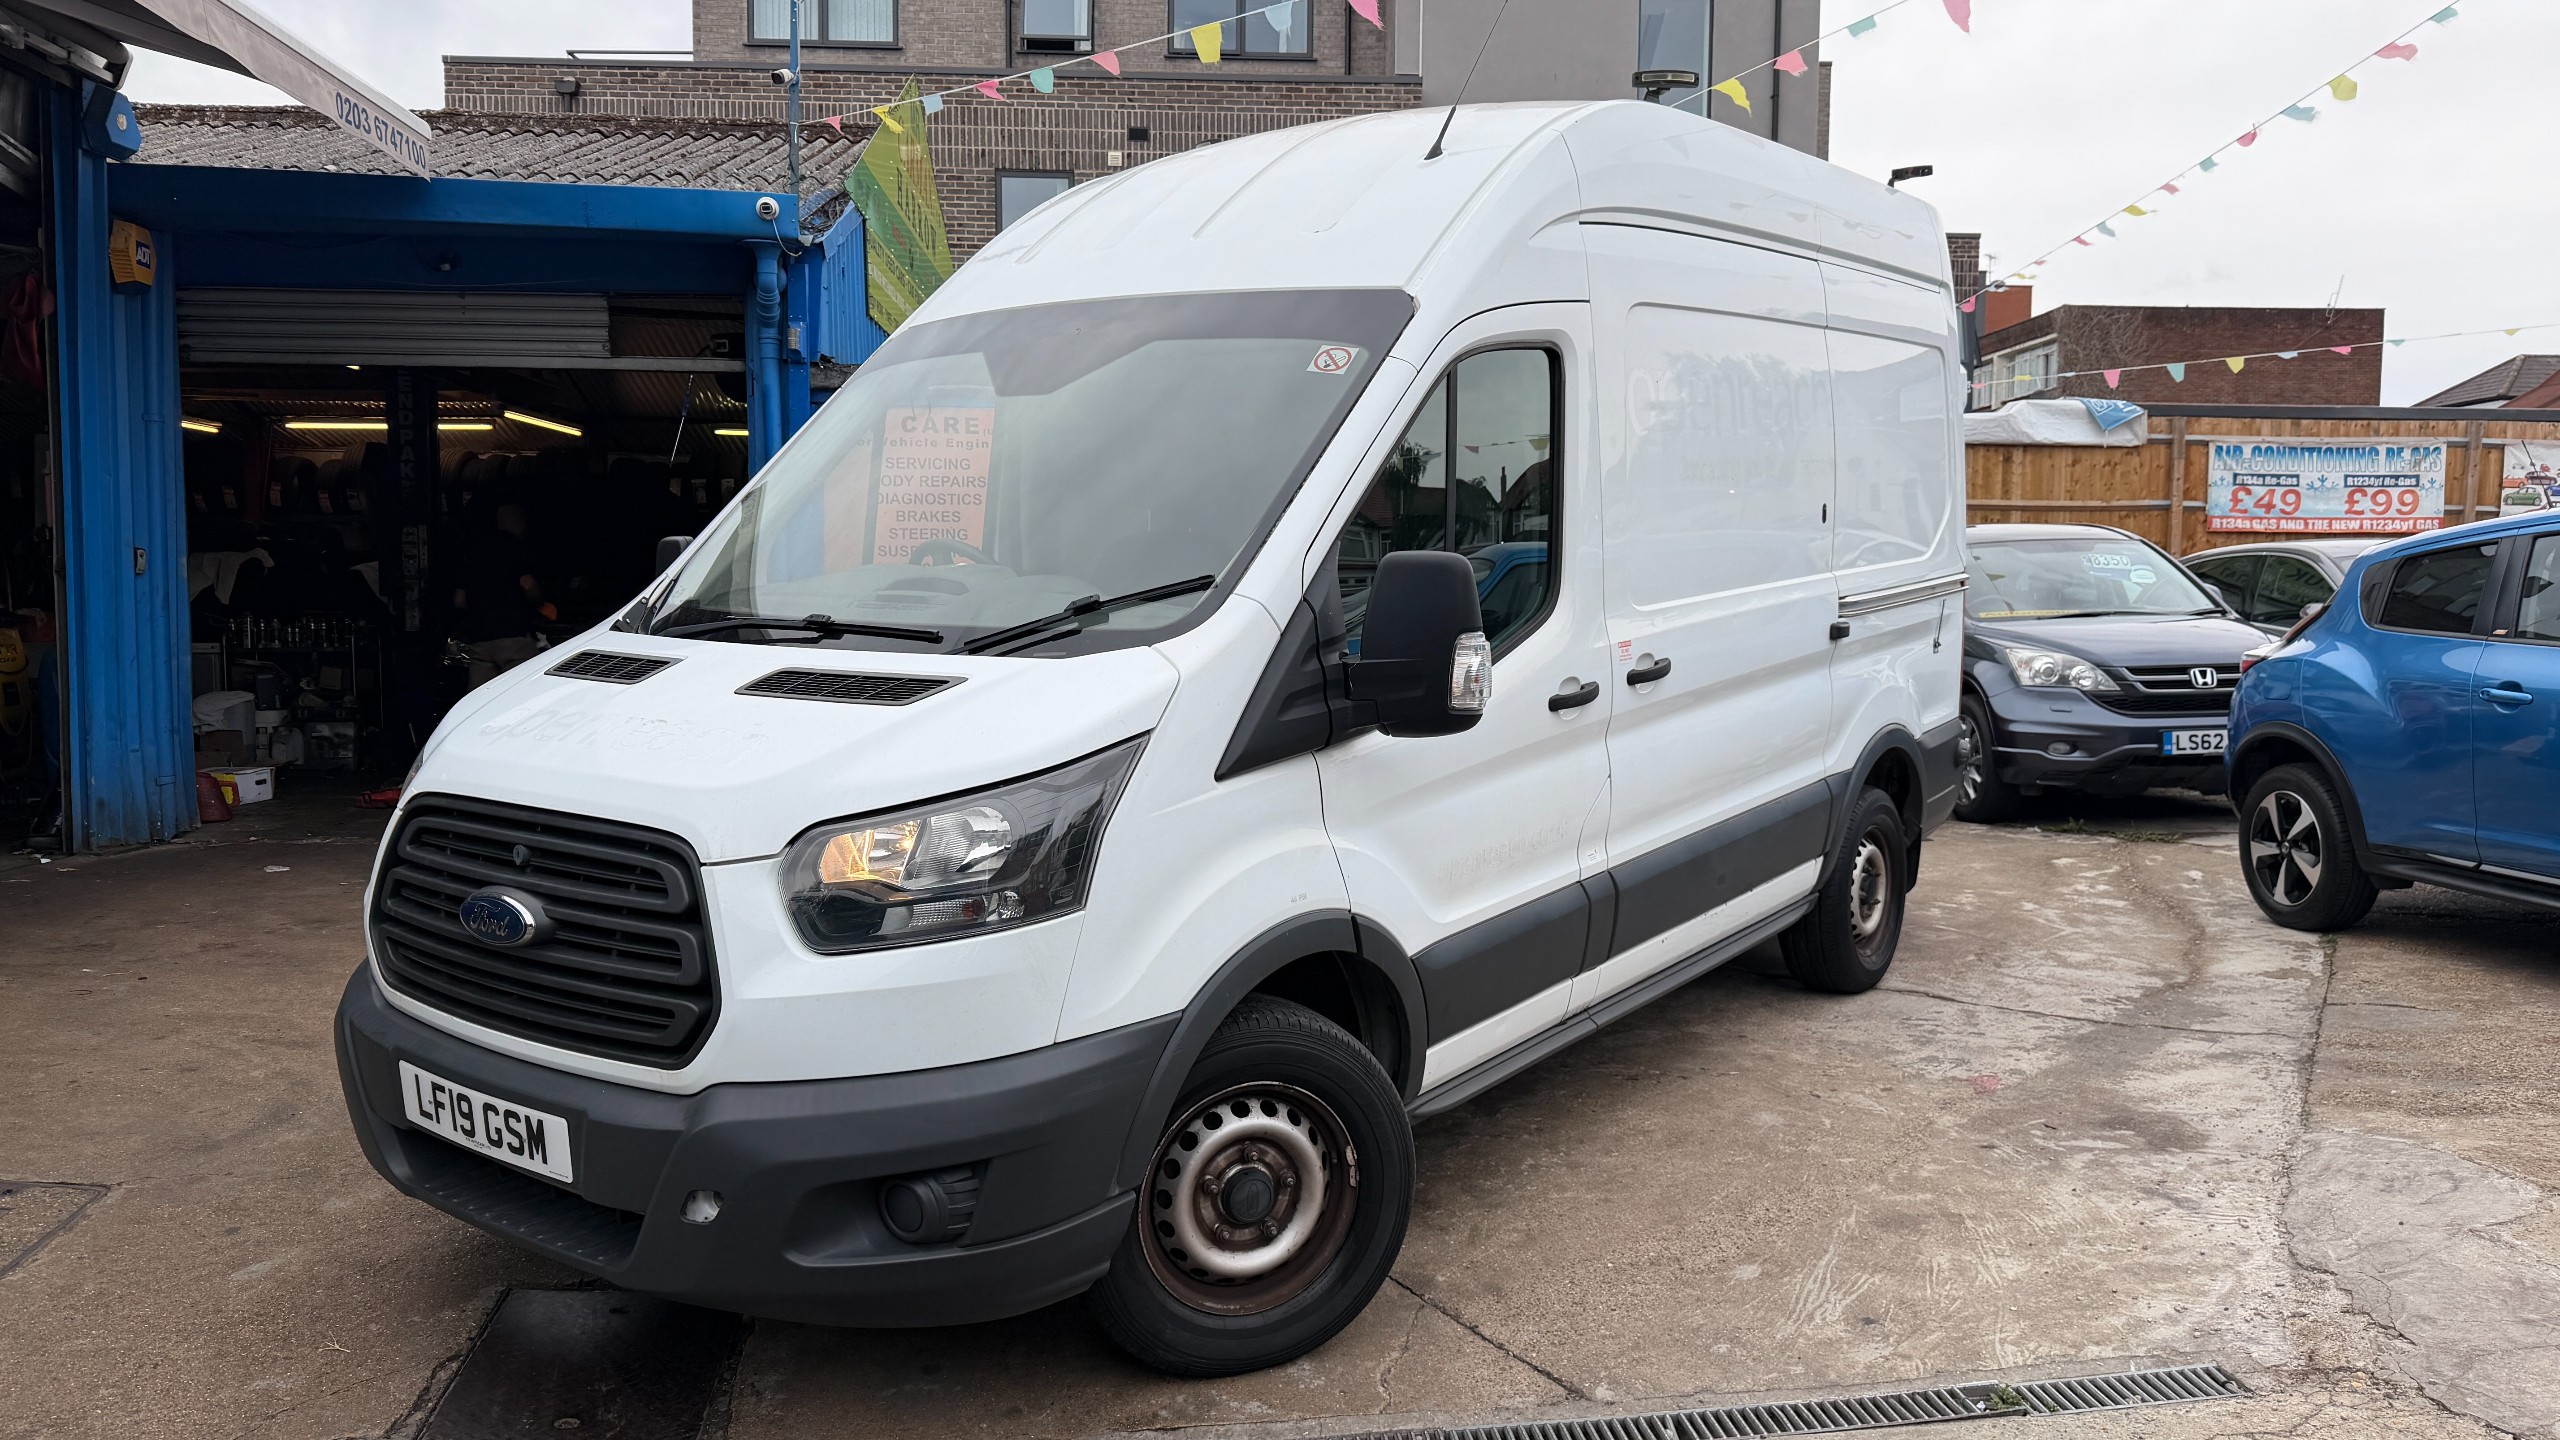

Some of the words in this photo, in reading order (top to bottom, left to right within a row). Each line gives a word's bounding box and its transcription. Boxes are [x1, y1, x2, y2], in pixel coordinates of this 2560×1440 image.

[335, 91, 372, 135] 0203
[374, 115, 426, 170] 6747100
[136, 245, 151, 265] ADT
[398, 369, 416, 478] ENDPAK
[901, 415, 980, 435] CARE
[885, 457, 971, 470] SERVICING
[2213, 445, 2380, 472] AIR-CONDITIONING
[2385, 446, 2442, 473] RE-GAS
[920, 475, 987, 488] REPAIRS
[2384, 477, 2417, 486] Re-Gas
[878, 493, 983, 506] DIAGNOSTICS
[2228, 486, 2302, 516] £49
[2344, 487, 2420, 516] £99
[896, 510, 961, 523] BRAKES
[2212, 518, 2251, 530] R134a
[2252, 518, 2277, 530] GAS
[2280, 519, 2305, 530] AND
[2307, 519, 2330, 530] THE
[2332, 519, 2361, 530] NEW
[2363, 519, 2414, 532] R1234yf
[2416, 519, 2440, 530] GAS
[889, 527, 968, 541] STEERING
[2176, 733, 2224, 751] LS62
[470, 902, 510, 937] Ford
[414, 1073, 476, 1139] LF19
[482, 1102, 548, 1165] GSM
